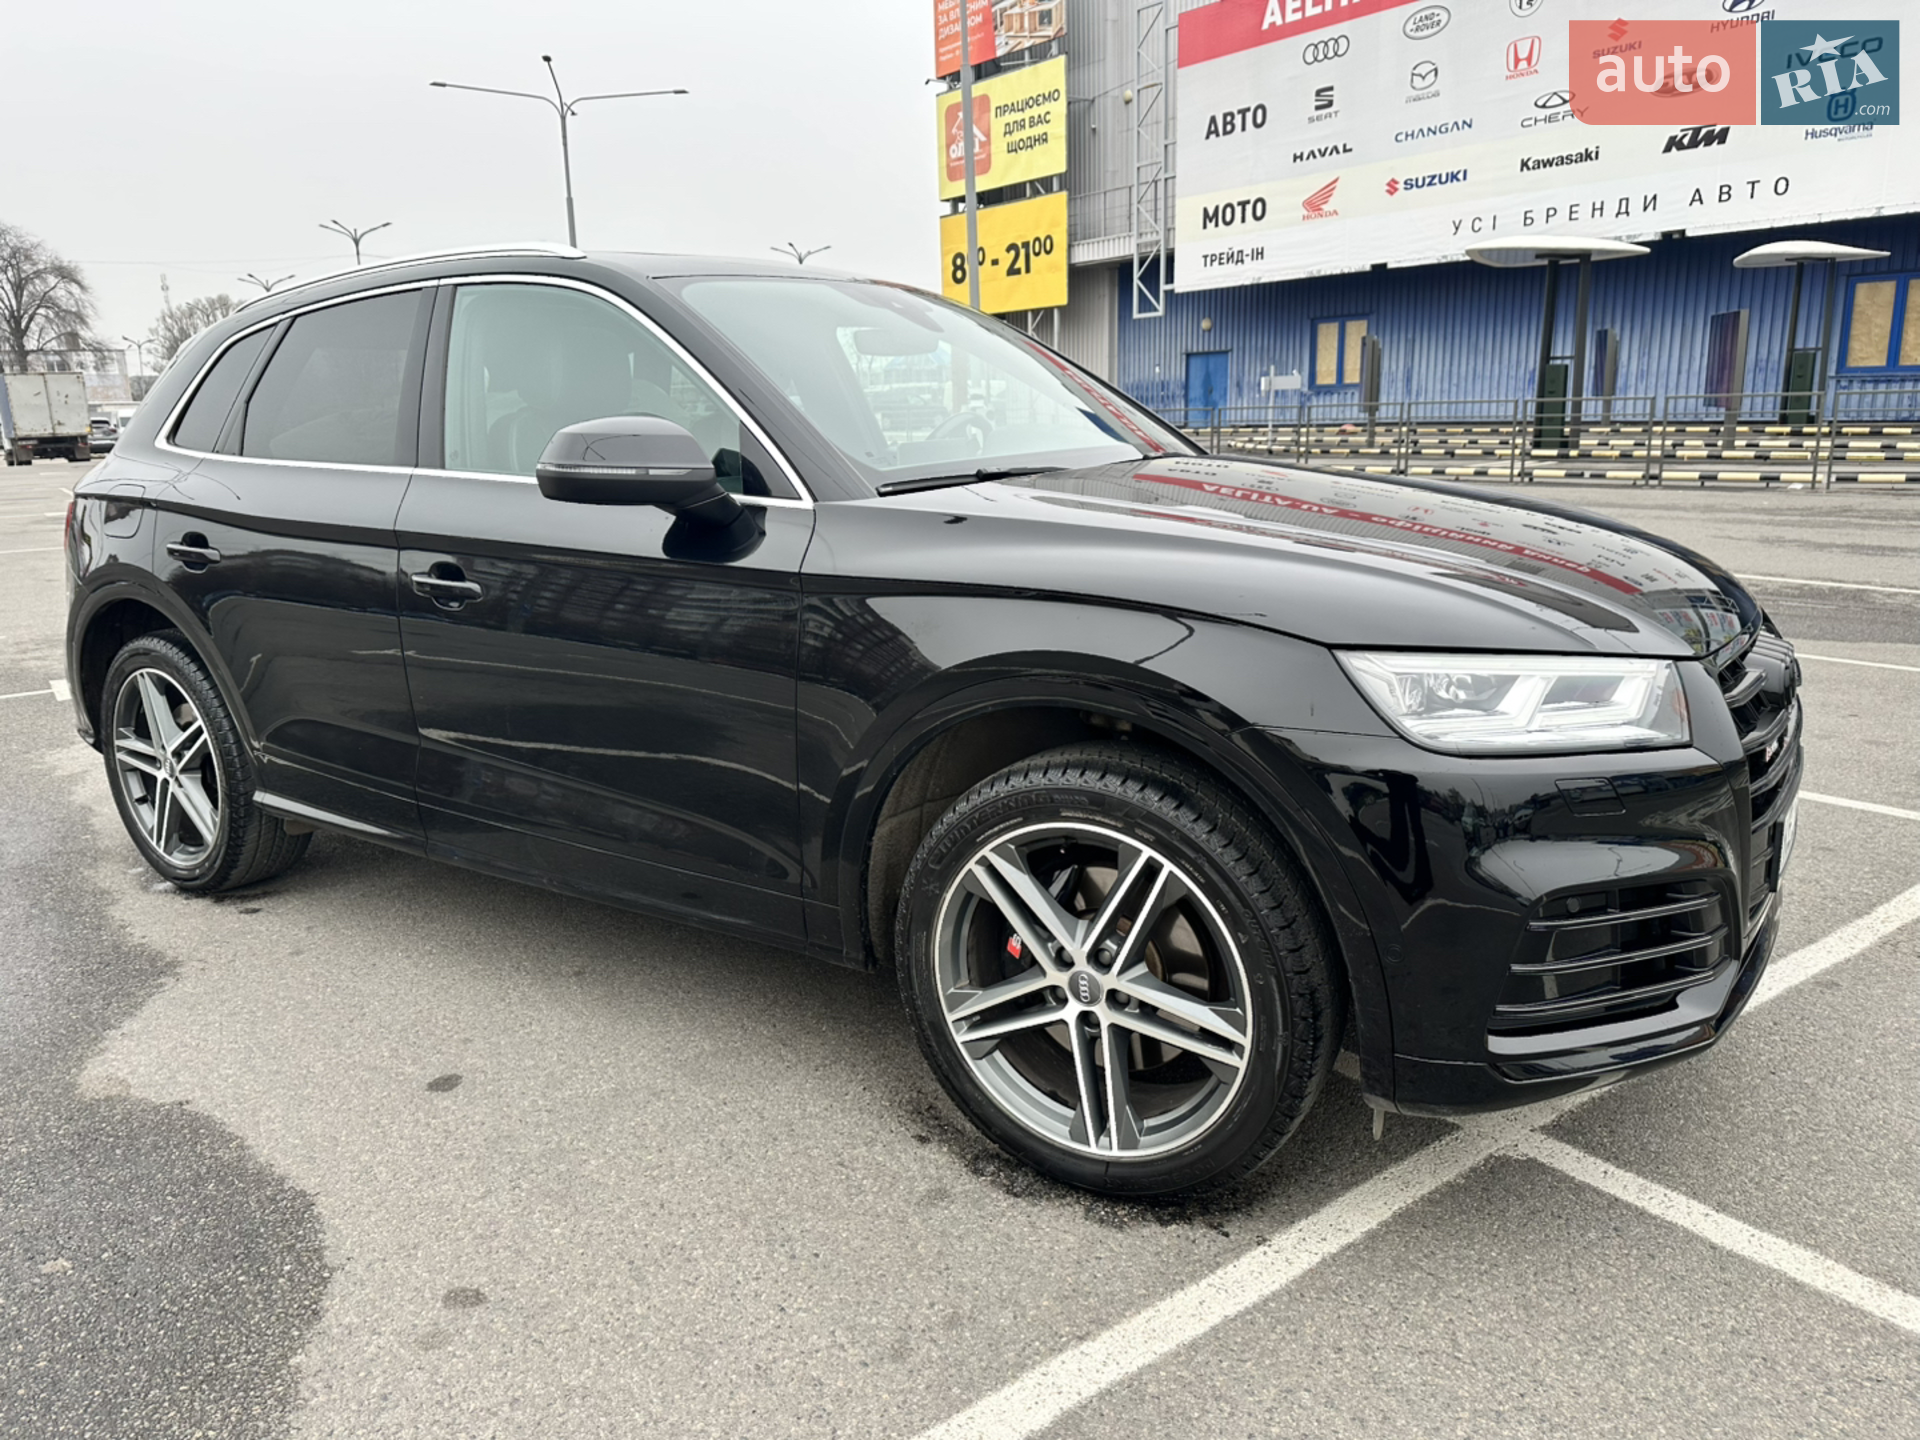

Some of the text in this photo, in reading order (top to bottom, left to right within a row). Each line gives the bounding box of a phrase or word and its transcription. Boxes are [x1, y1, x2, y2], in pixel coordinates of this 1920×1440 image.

[1412, 12, 1436, 25] LAND
[1414, 19, 1442, 34] ROVER
[1505, 68, 1539, 81] HONDA
[995, 88, 1060, 118] ПРАЦЮЄМО
[1003, 111, 1051, 138] ДЛЯ ВАС
[1204, 103, 1267, 140] АВТО
[1307, 110, 1340, 124] SEAT
[1520, 106, 1589, 128] CHERY
[1394, 117, 1473, 143] CHANGAN
[1661, 123, 1731, 154] KTM
[1006, 132, 1048, 154] ЩОДНЯ
[1292, 143, 1353, 163] HAVAL
[1520, 145, 1600, 172] Kawasaki
[1403, 168, 1468, 191] SUZUKI
[1202, 196, 1267, 230] МОТО
[1302, 209, 1339, 221] HONDA
[1452, 176, 1790, 235] УСІ БРЕНДИ АВТО
[1202, 246, 1264, 267] ТРЕЙД-ІН
